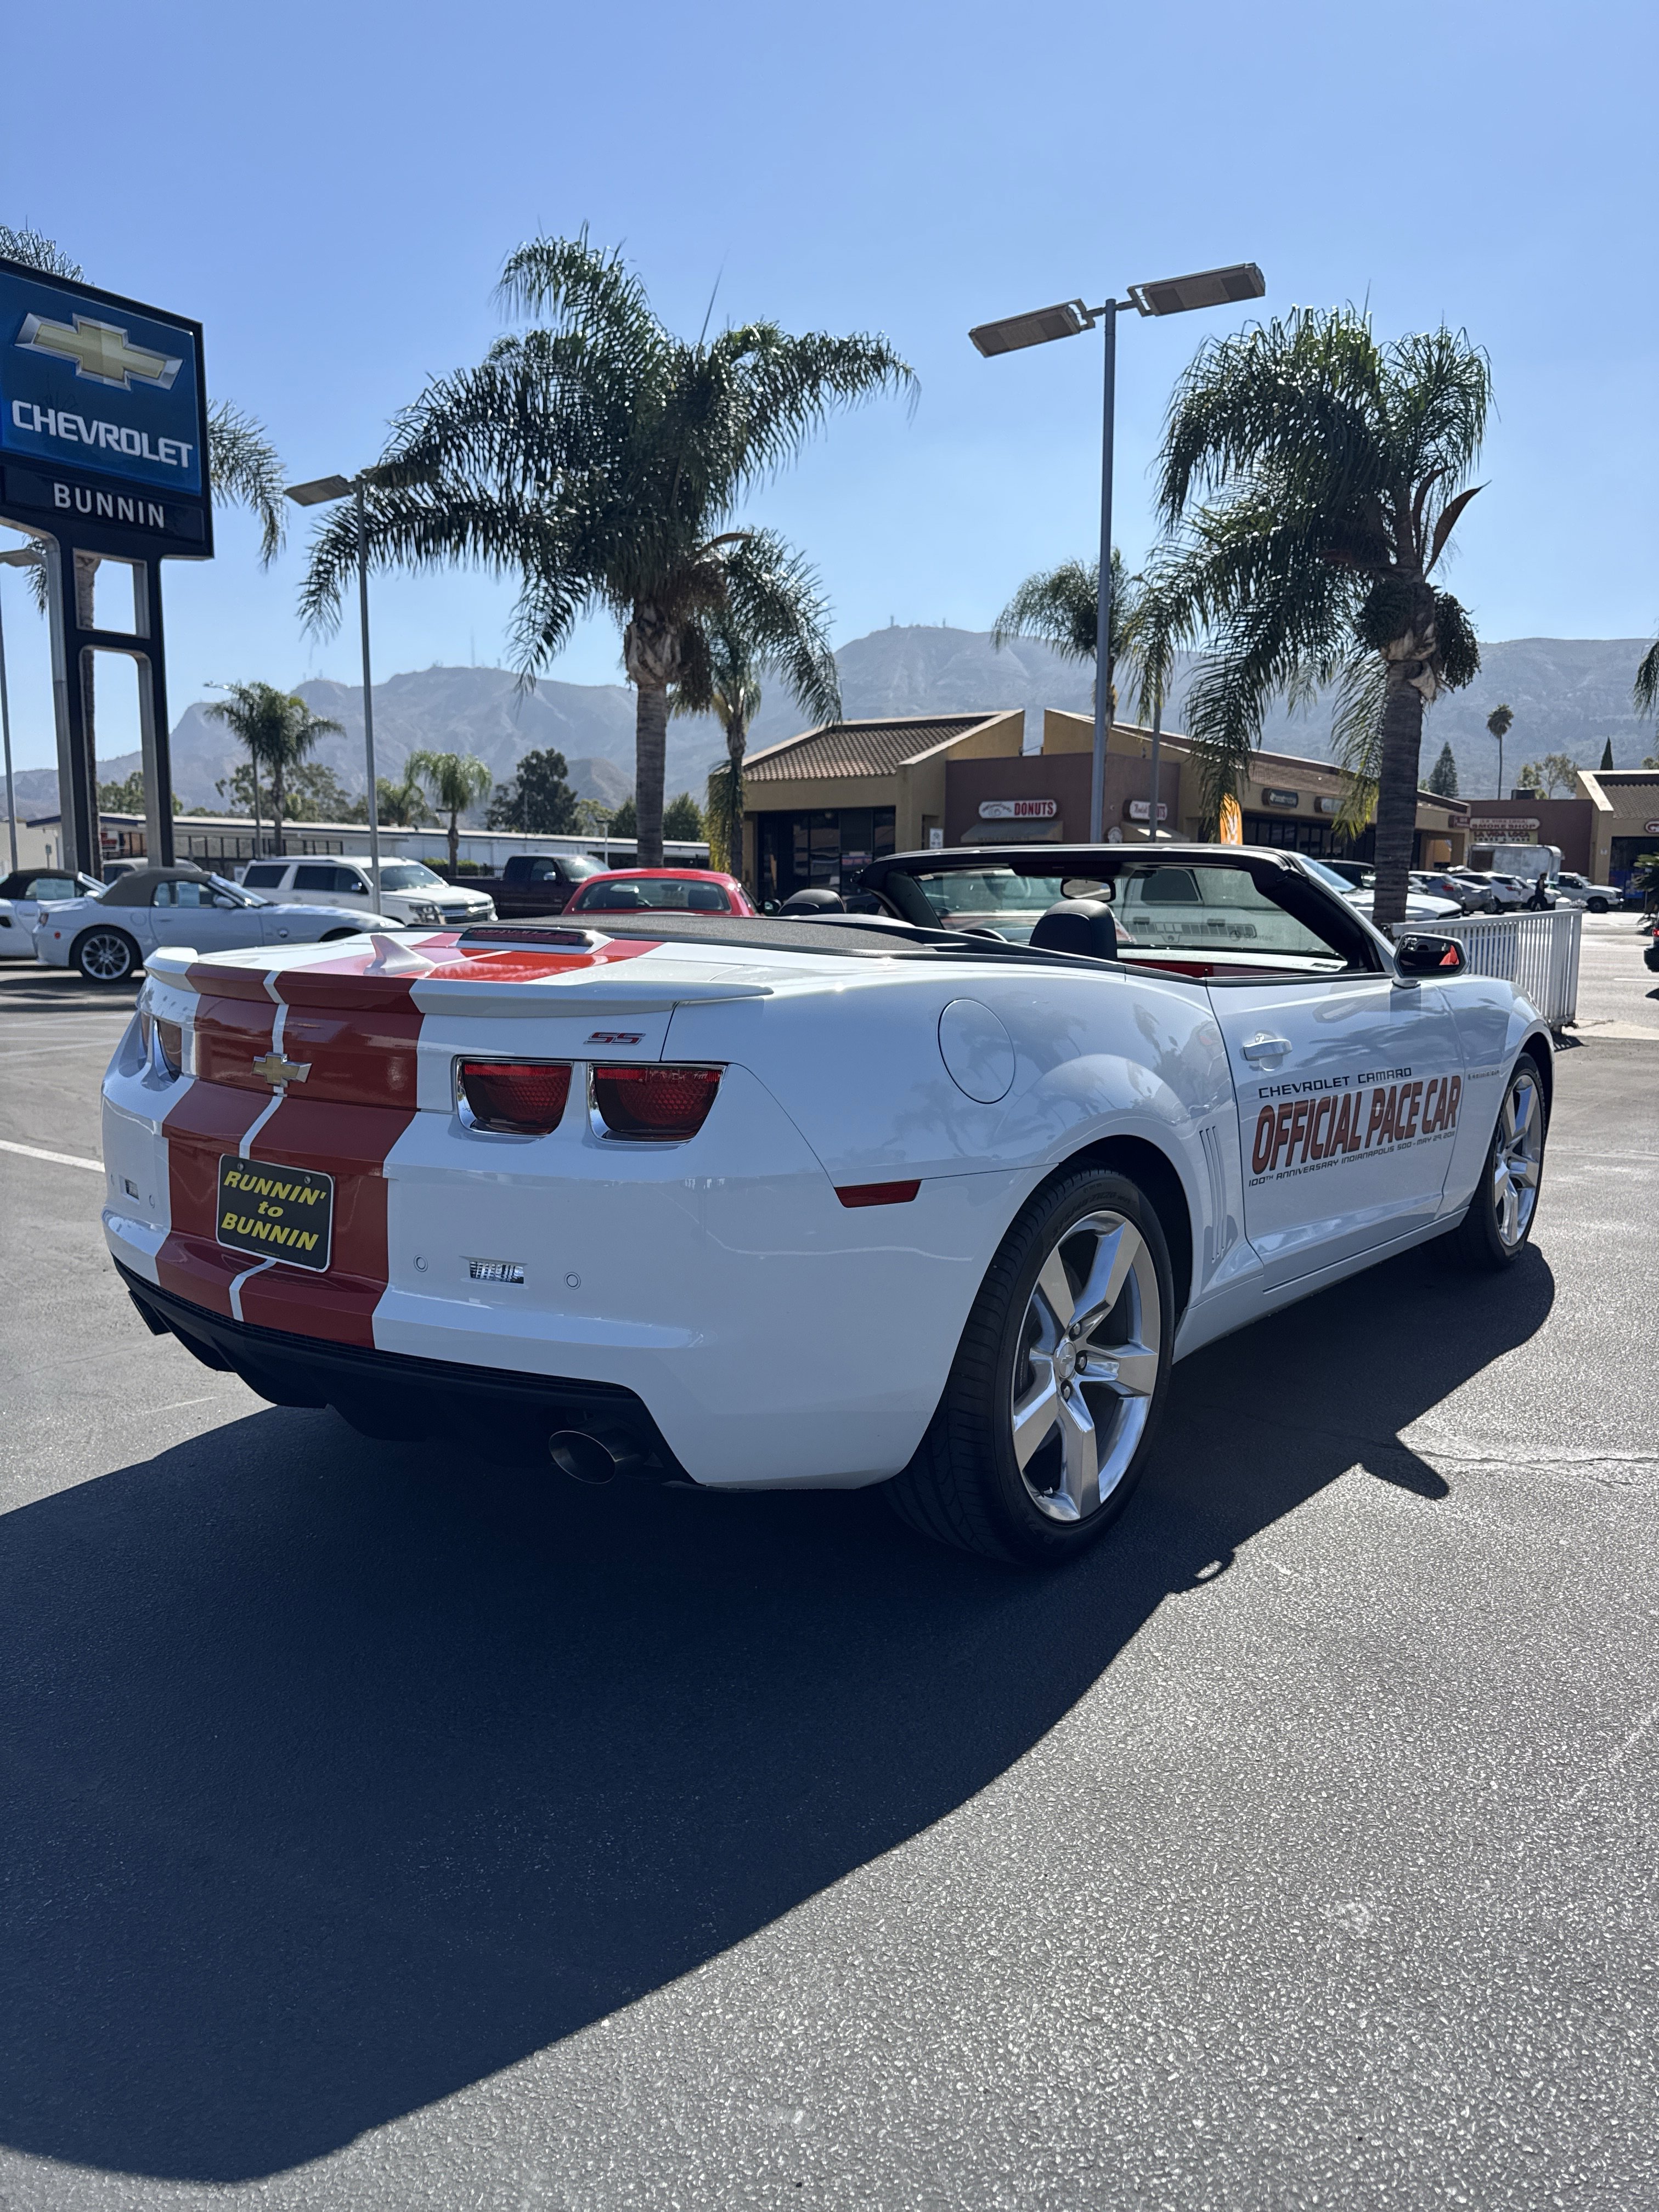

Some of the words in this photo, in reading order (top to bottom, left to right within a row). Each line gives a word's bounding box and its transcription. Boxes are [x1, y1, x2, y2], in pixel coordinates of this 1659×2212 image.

[12, 400, 193, 469] CHEVROLET
[54, 483, 165, 529] BUNNIN
[1014, 802, 1053, 816] DONUTS
[583, 1032, 646, 1045] SS
[1258, 1075, 1350, 1098] CHEVROLET
[1357, 1067, 1412, 1084] CAMARO
[1251, 1091, 1362, 1175] OFFICIAL
[1364, 1081, 1423, 1149] PACE
[1421, 1075, 1462, 1135] CAR
[1276, 1159, 1339, 1181] ANNIVERSARY
[1341, 1146, 1395, 1164] INDIANAPOLIS
[1397, 1142, 1412, 1150] 500
[1417, 1137, 1432, 1146] MAY
[223, 1170, 327, 1205] RUNNIN'
[257, 1201, 284, 1217] to
[221, 1212, 319, 1251] BUNNIN
